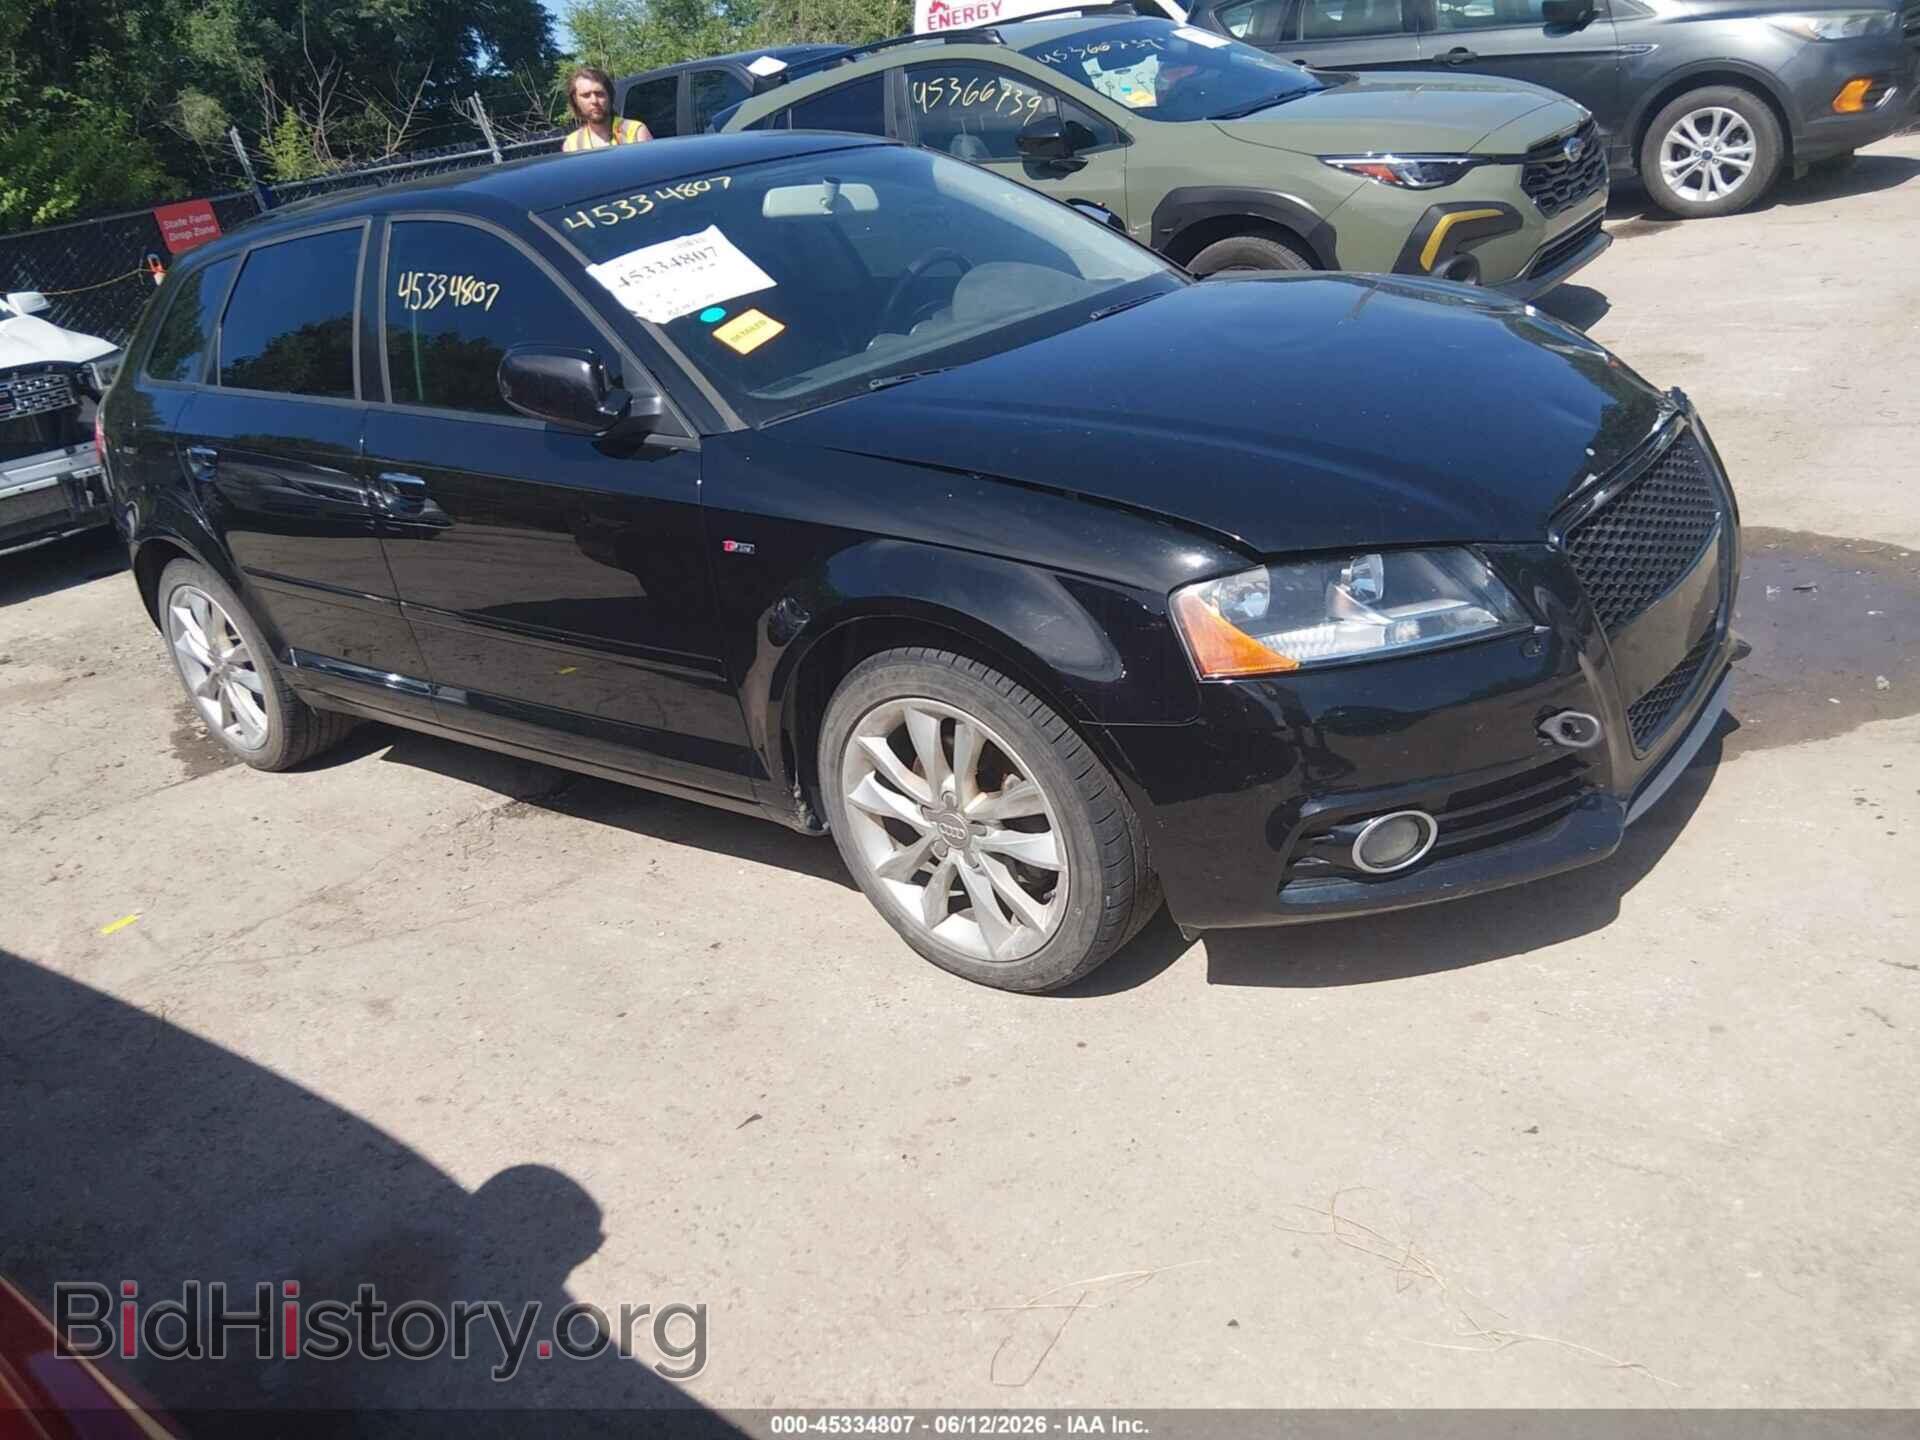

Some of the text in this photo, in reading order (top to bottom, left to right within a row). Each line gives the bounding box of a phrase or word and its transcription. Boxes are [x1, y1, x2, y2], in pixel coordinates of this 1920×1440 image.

[927, 2, 1002, 31] ENERGY
[912, 74, 1043, 126] 45366739
[563, 175, 732, 230] 45334807
[397, 271, 500, 312] 45334807
